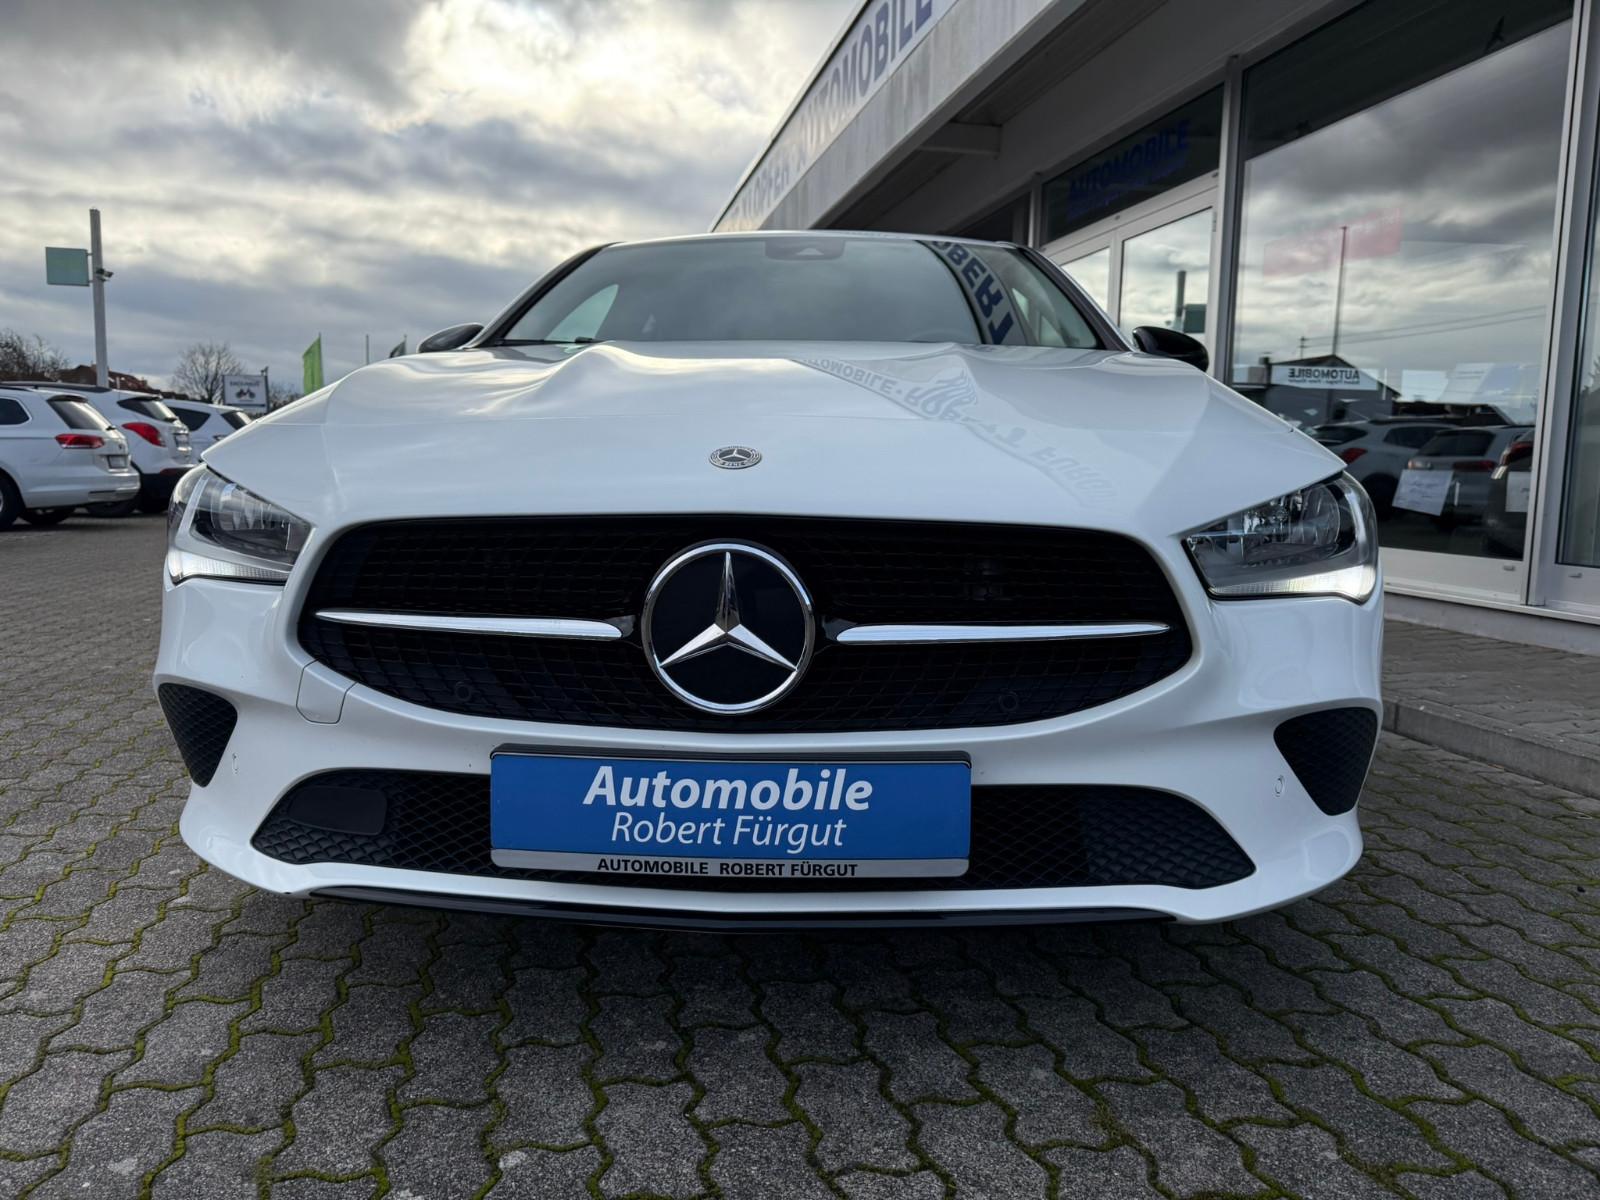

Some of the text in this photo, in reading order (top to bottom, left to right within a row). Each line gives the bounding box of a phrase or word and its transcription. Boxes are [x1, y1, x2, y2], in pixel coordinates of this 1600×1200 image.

[582, 765, 873, 811] Automobile
[611, 811, 847, 854] Robert Fürgut
[597, 858, 858, 876] AUTOMOBILE ROBERT FÜRGUT
